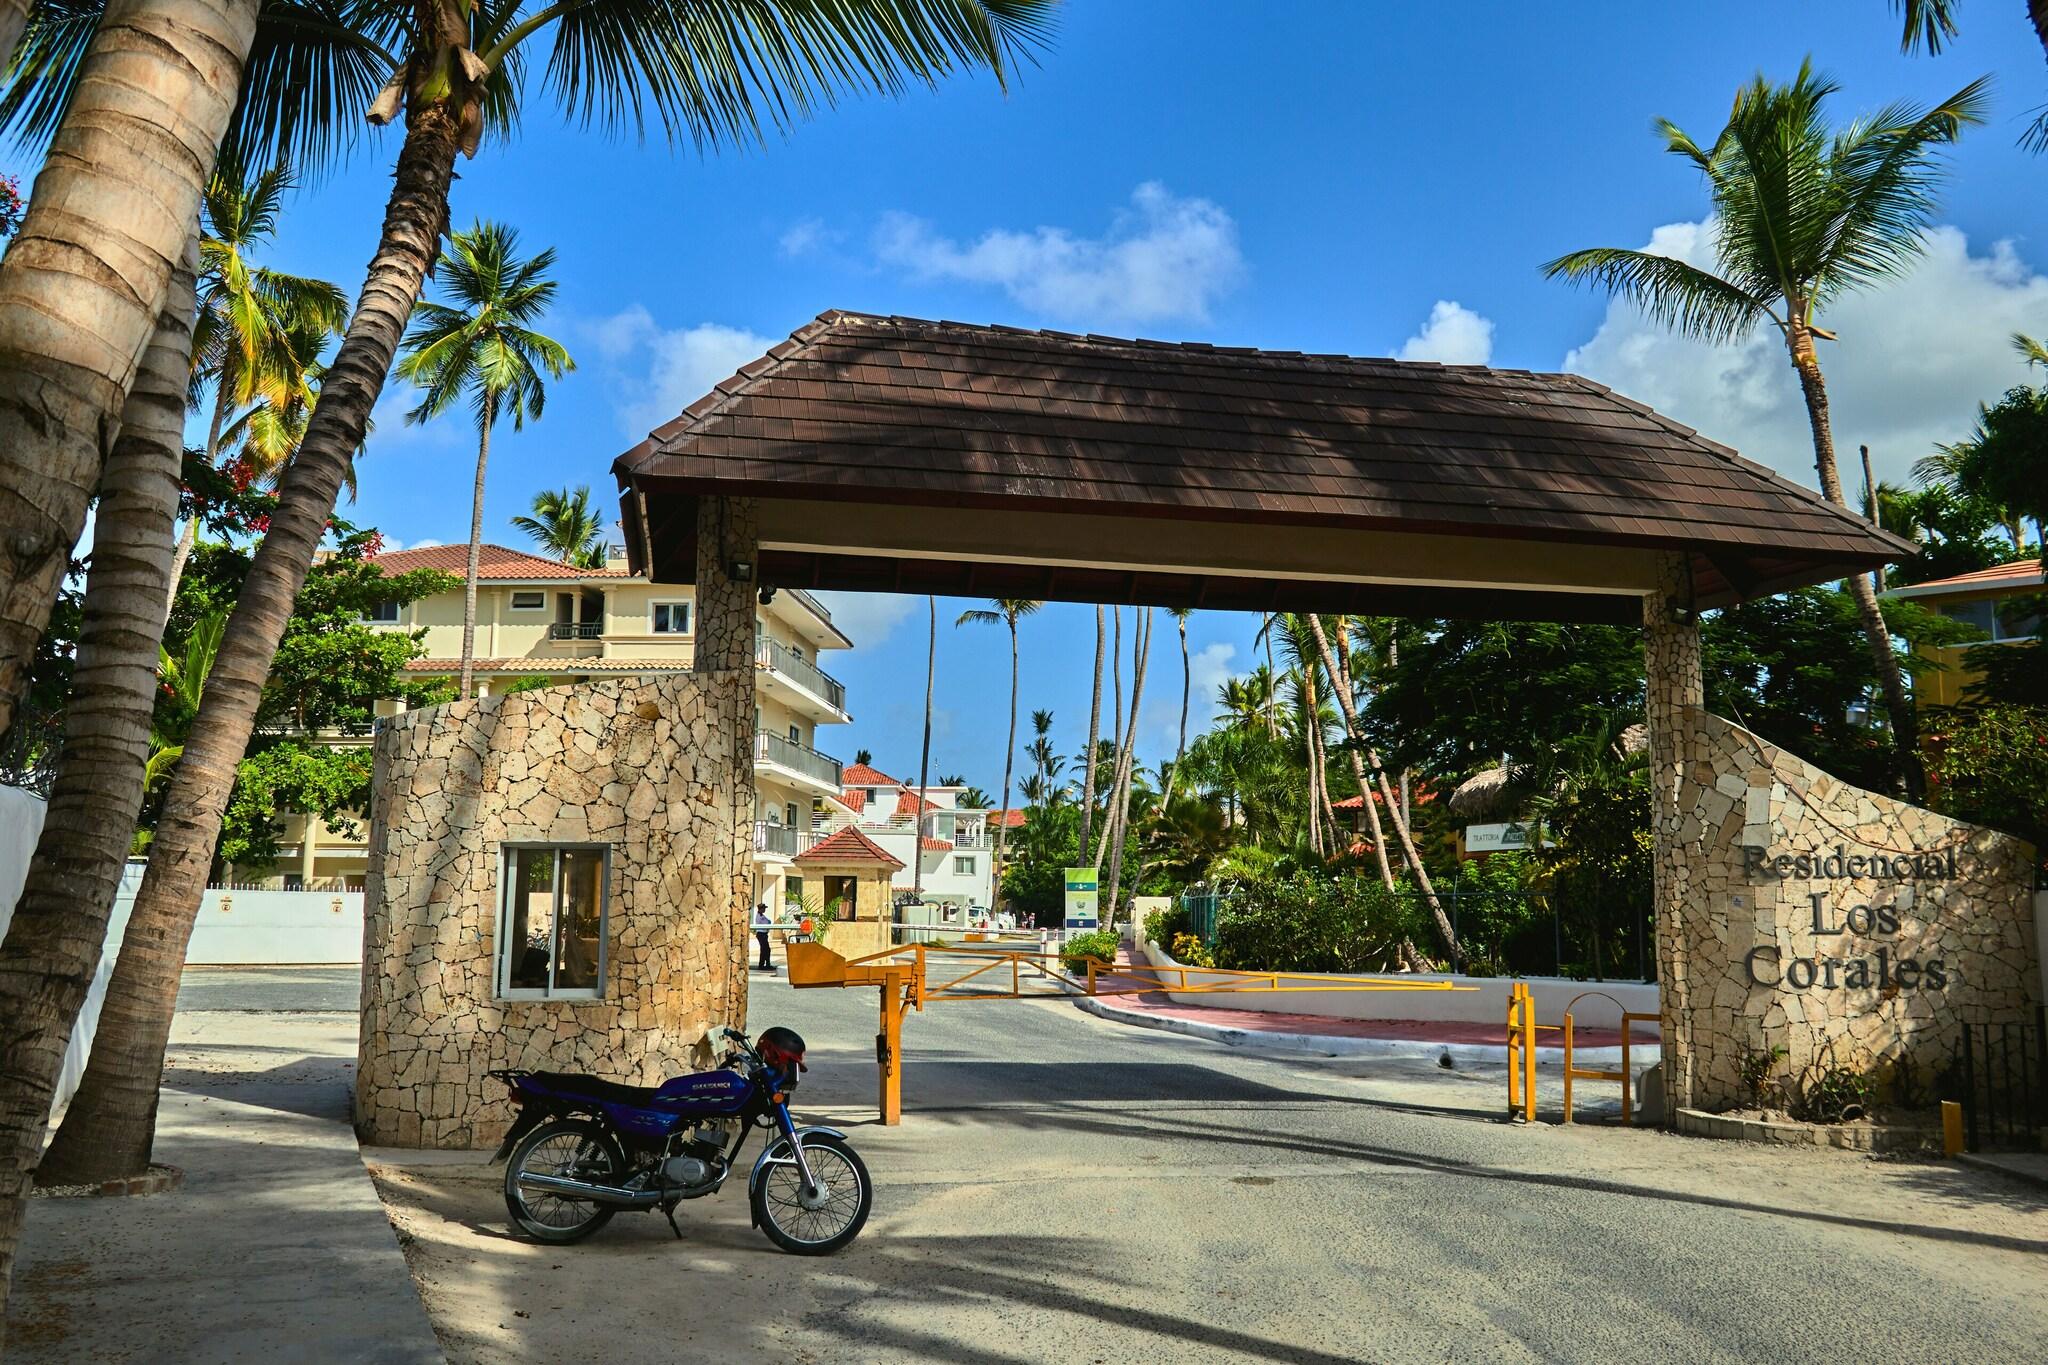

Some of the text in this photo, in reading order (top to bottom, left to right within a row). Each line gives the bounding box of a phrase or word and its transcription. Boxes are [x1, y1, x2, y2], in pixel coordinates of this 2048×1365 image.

[1744, 844, 1957, 880] Residencial
[1808, 892, 1900, 936] Los
[1744, 946, 1947, 990] Corales
